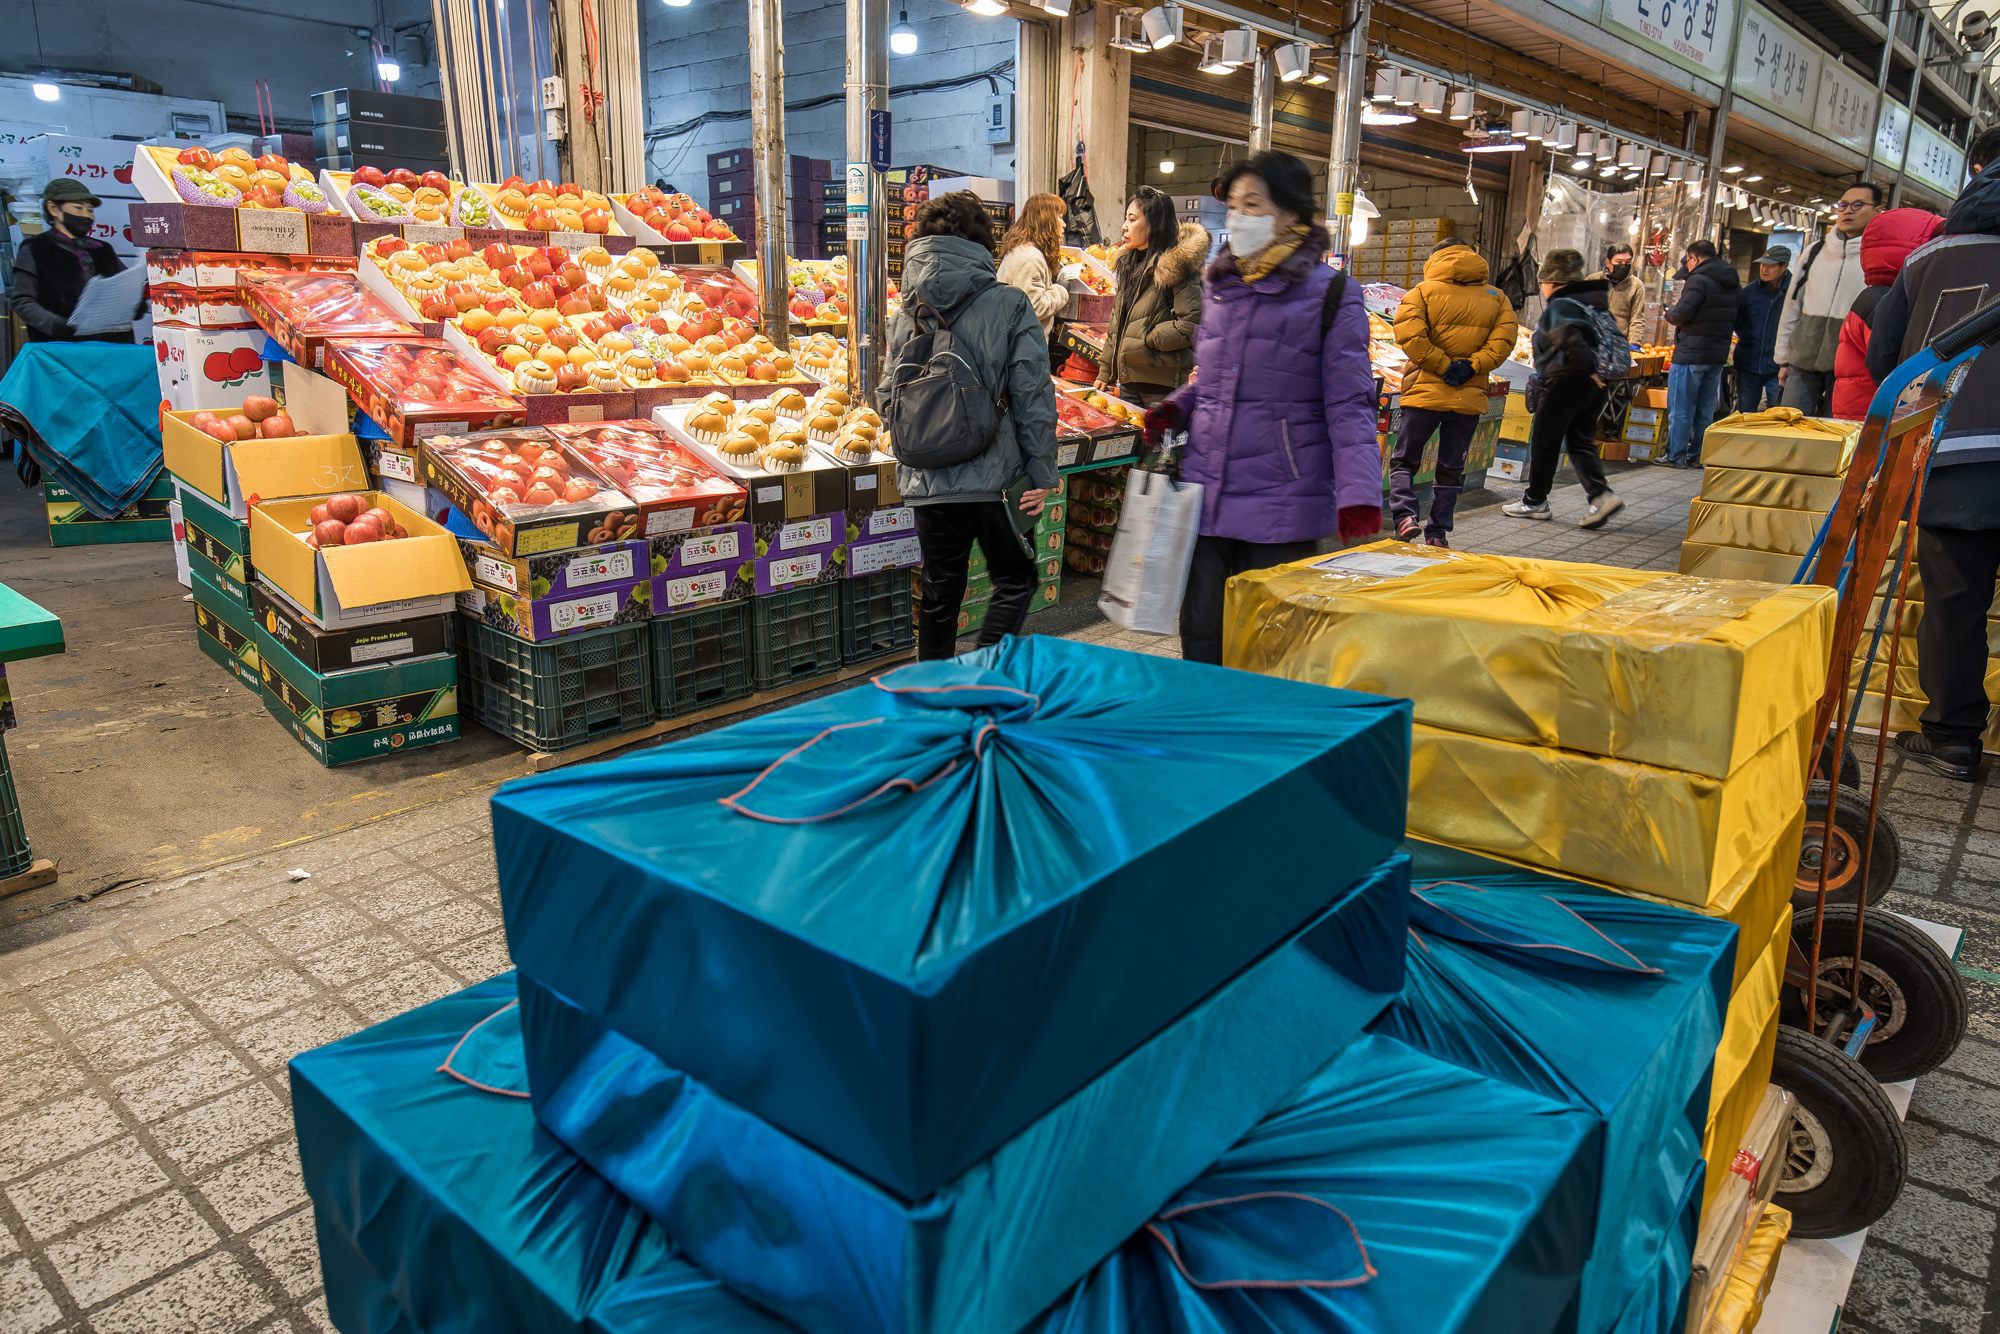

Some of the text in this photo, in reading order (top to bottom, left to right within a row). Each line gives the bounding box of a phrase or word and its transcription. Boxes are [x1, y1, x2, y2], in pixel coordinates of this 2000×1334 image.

[1754, 33, 1808, 104] 우성상회
[1828, 82, 1870, 132] 세운상회
[65, 163, 108, 178] 사과
[338, 366, 363, 399] 명품사과
[438, 474, 468, 510] 명품사과
[572, 566, 588, 576] 포도
[708, 580, 720, 590] 포도
[596, 602, 612, 613] 포도
[408, 724, 453, 740] 농업회사법인
[373, 737, 389, 748] 농산
